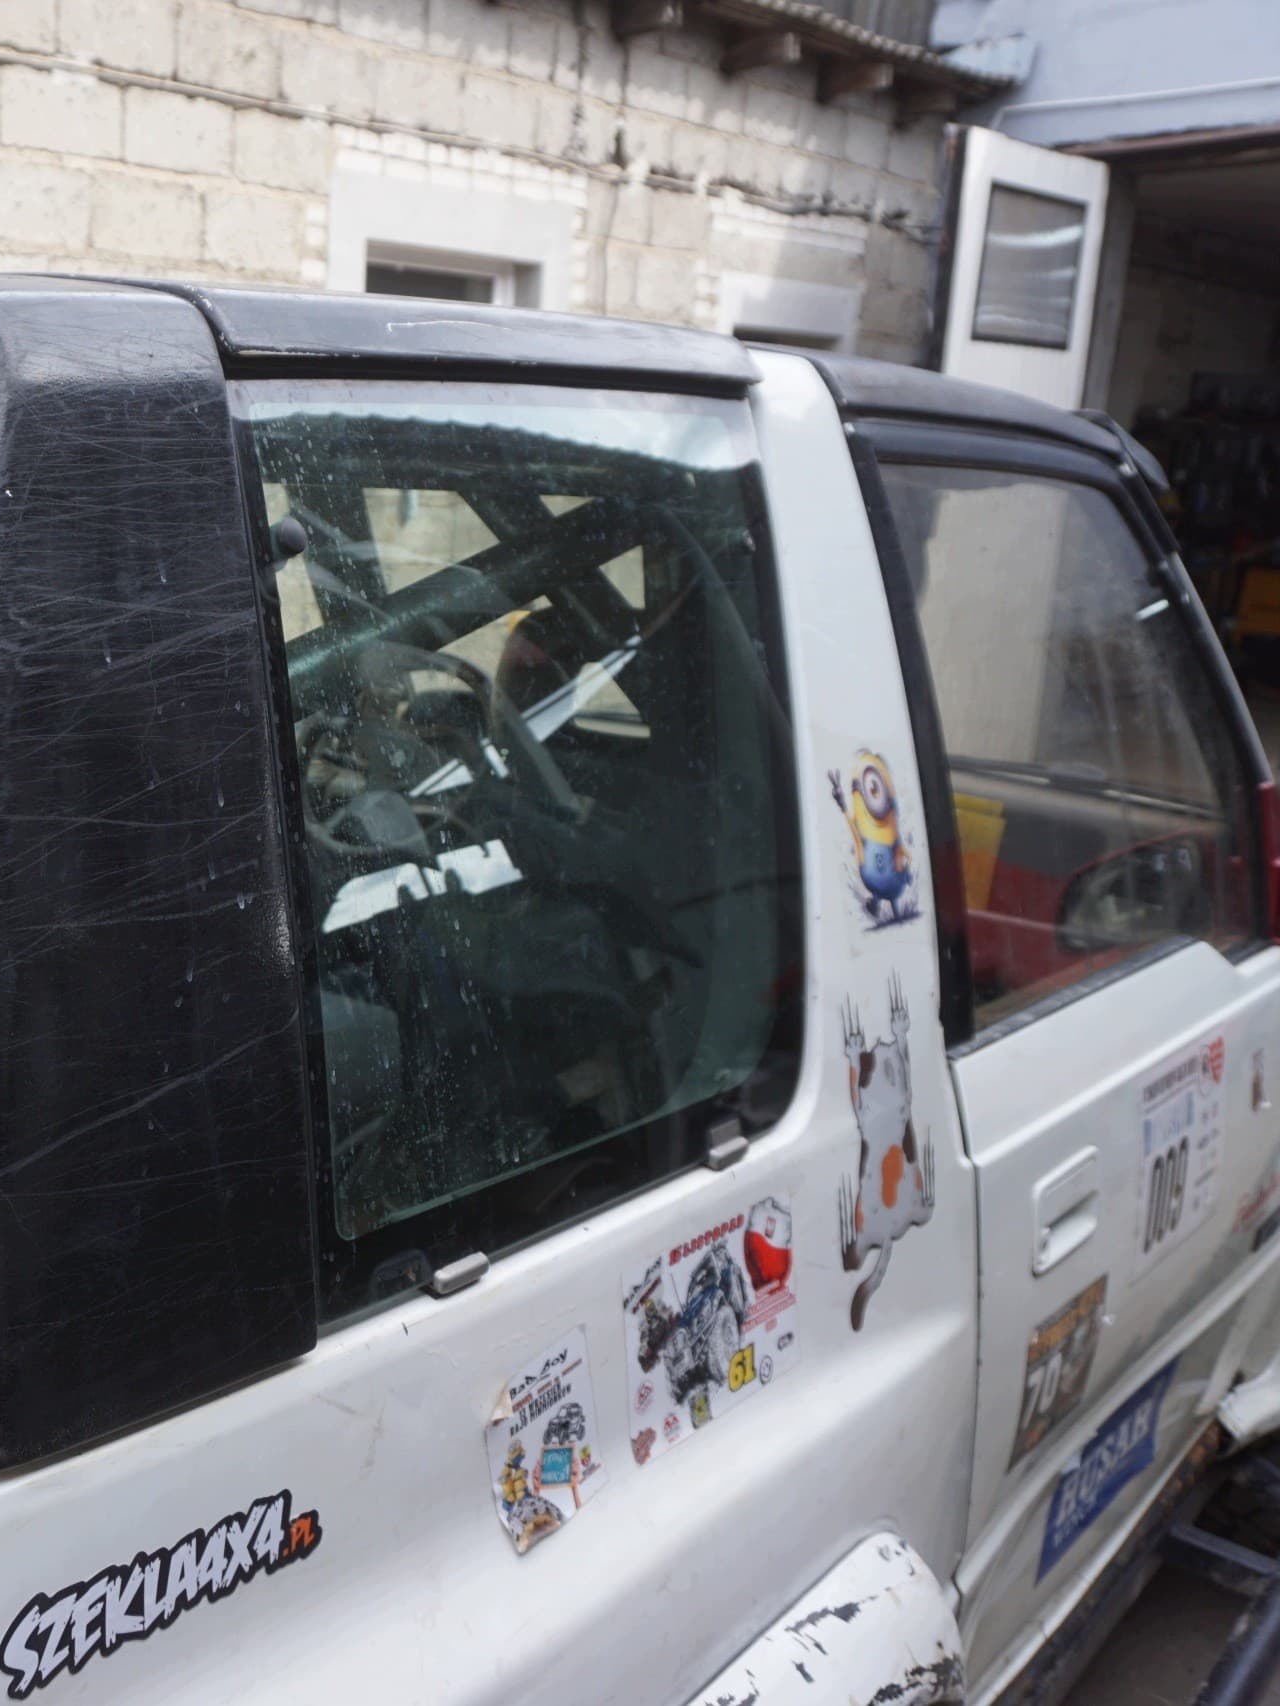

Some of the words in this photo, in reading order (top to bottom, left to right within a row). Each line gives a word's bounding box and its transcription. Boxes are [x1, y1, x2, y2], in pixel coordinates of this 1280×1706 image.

[728, 1342, 756, 1392] 61
[1022, 1351, 1063, 1428] 70
[1055, 1399, 1155, 1529] HUSAR
